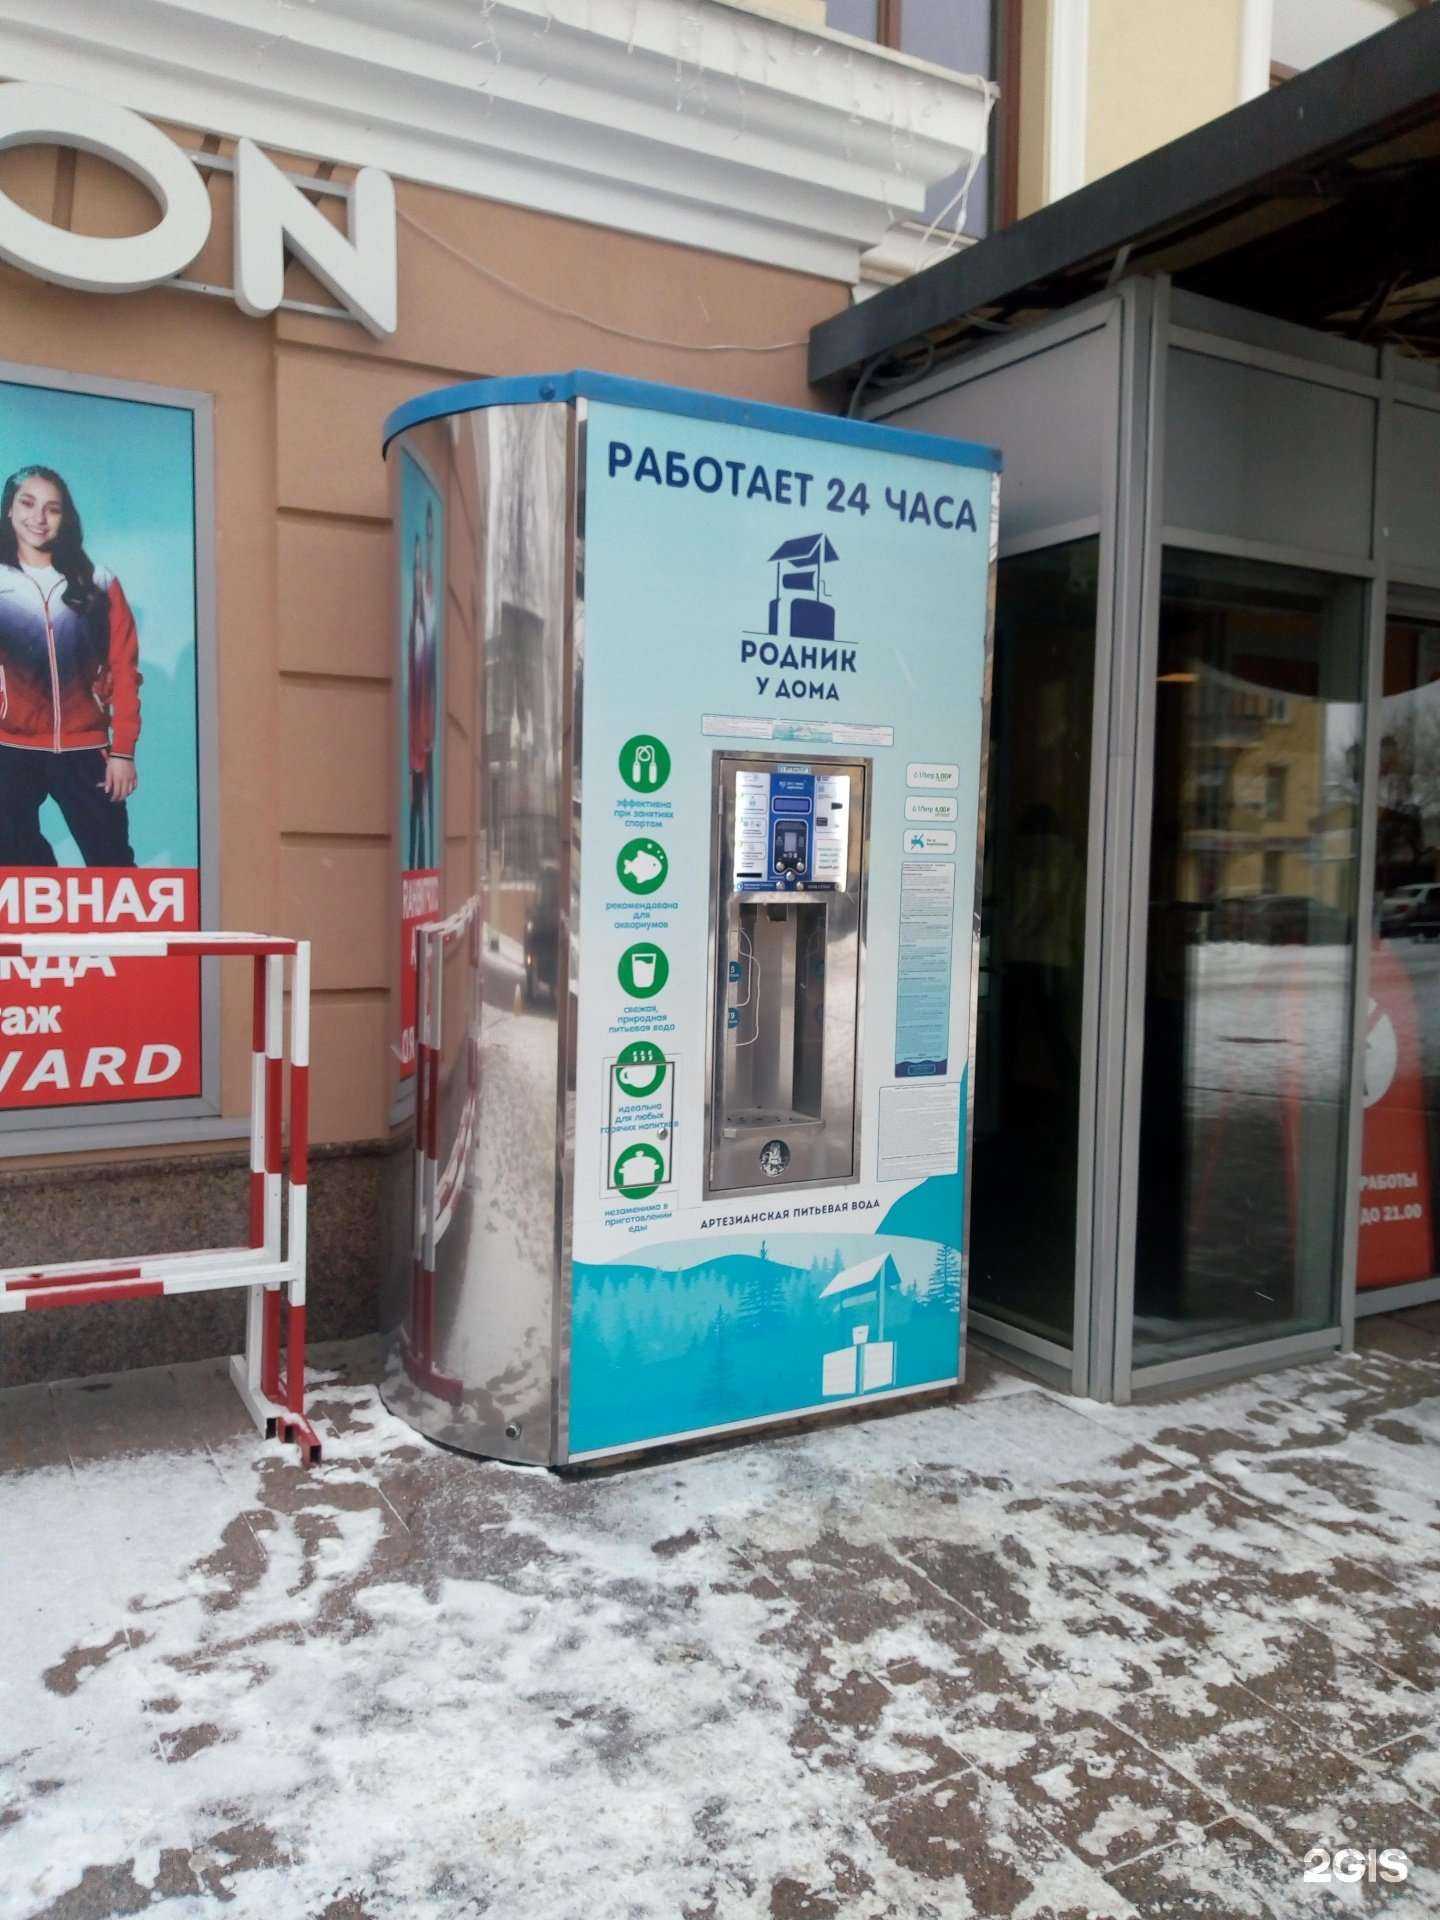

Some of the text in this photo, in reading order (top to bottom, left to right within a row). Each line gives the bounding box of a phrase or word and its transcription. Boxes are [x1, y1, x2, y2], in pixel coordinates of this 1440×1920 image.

[608, 441, 978, 533] РАБОТАЕТ 24 ЧАСА
[741, 639, 857, 673] РОДНИК
[756, 677, 840, 701] У ДОМА
[613, 809, 631, 819] при
[624, 819, 663, 829] спортом
[606, 901, 679, 911] рекомендована
[633, 911, 650, 921] для
[614, 920, 669, 931] аквариумов
[0, 1004, 62, 1036] аж
[617, 1014, 667, 1025] природная
[608, 1023, 676, 1033] питьевая вода
[615, 1112, 664, 1124] для любых
[600, 1124, 636, 1134] горячих
[604, 1211, 672, 1228] приготовлении
[700, 1198, 880, 1230] АРТЕЗИАНСКАЯ ПИТЬЕВАЯ ВОДА
[628, 1224, 648, 1234] еды
